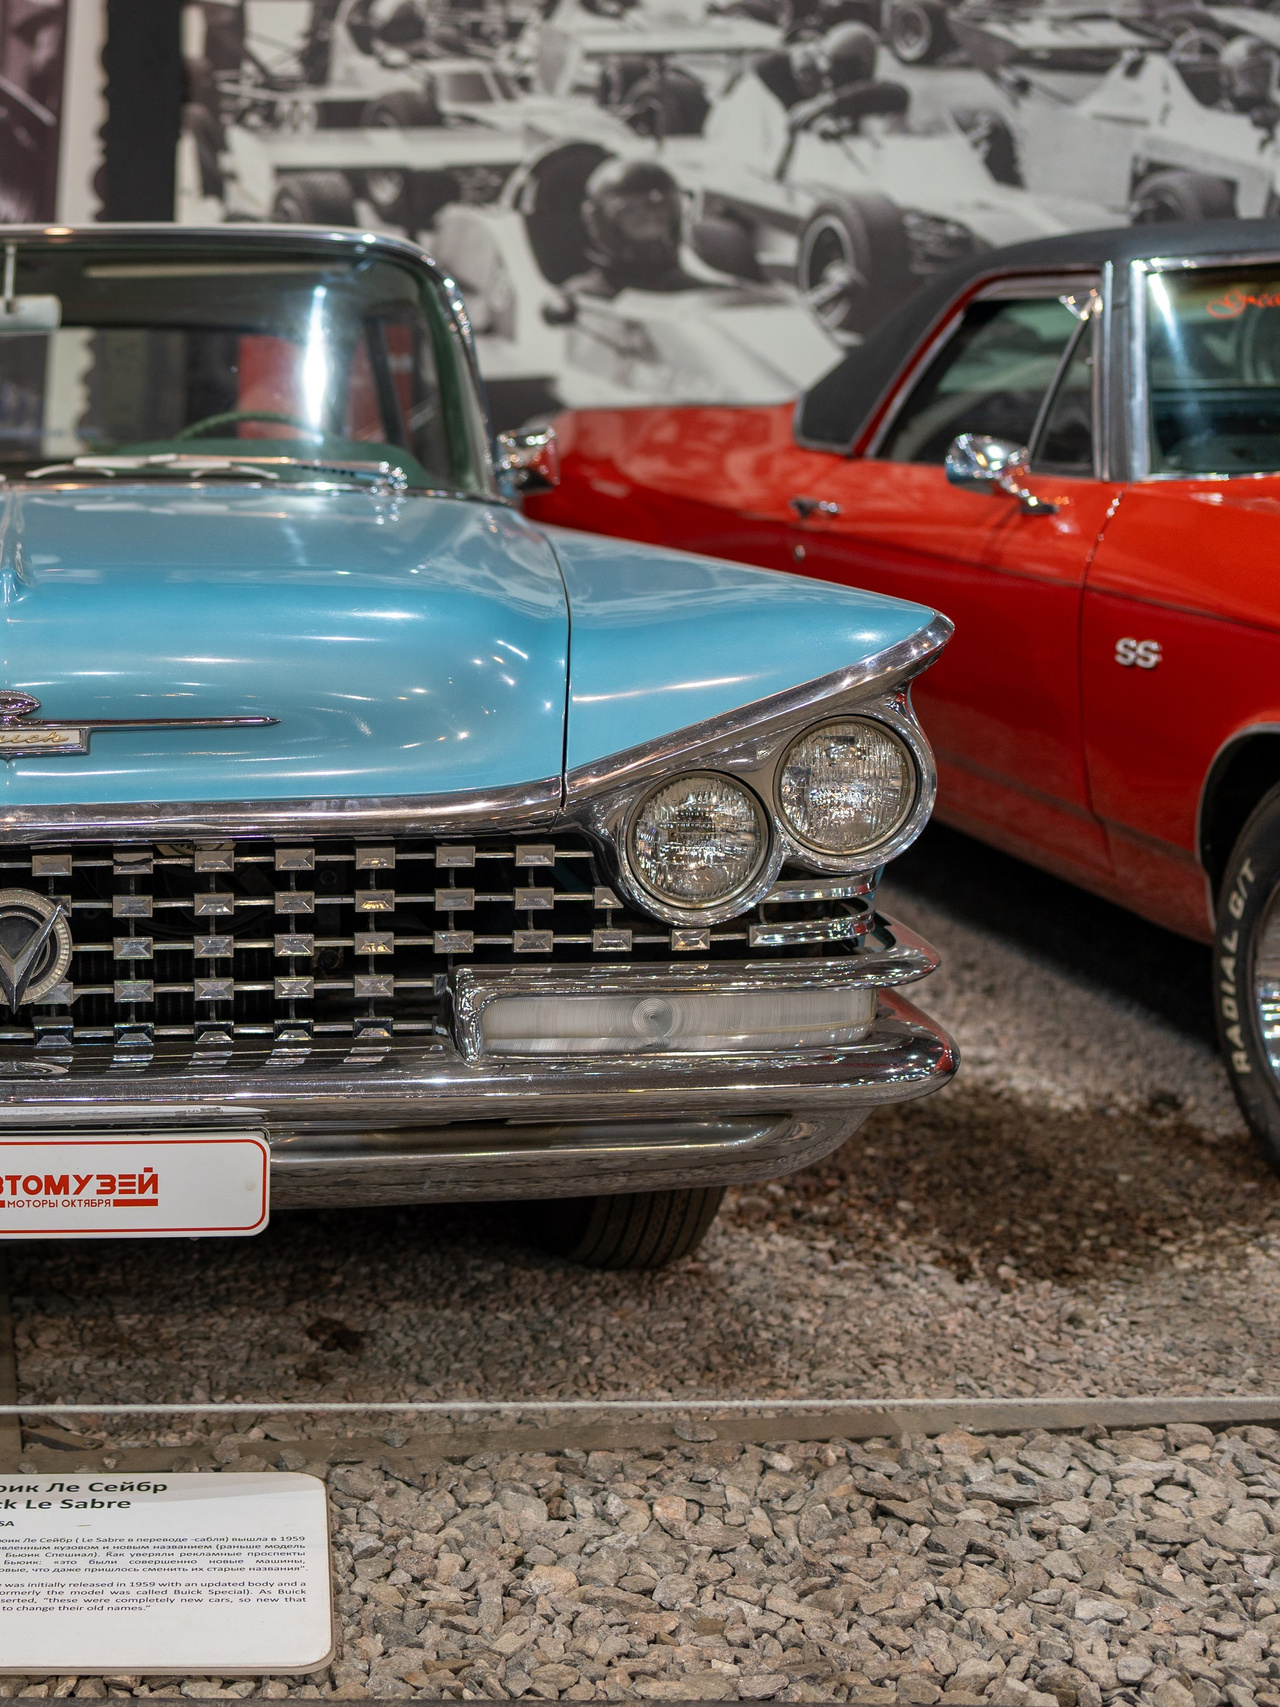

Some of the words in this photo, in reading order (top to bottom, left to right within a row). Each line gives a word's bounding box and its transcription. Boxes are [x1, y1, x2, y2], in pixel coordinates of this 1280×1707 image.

[1114, 637, 1163, 669] SS
[1229, 858, 1256, 920] G/T
[1221, 930, 1251, 1074] RADIAL
[7, 1199, 59, 1208] МОТОРЫ
[61, 1198, 111, 1208] ОКТЯБРЯ
[45, 1482, 81, 1493] Ле
[87, 1481, 168, 1494] Сейбр
[25, 1499, 53, 1510] Le
[59, 1498, 132, 1510] Sabre
[105, 1550, 125, 1558] Как
[27, 1581, 67, 1589] initially
[200, 1581, 246, 1589] updated
[247, 1580, 275, 1588] body
[135, 1588, 168, 1596] called
[173, 1588, 203, 1596] Buick
[114, 1596, 176, 1604] completely
[15, 1605, 56, 1613] change
[86, 1604, 105, 1612] old
